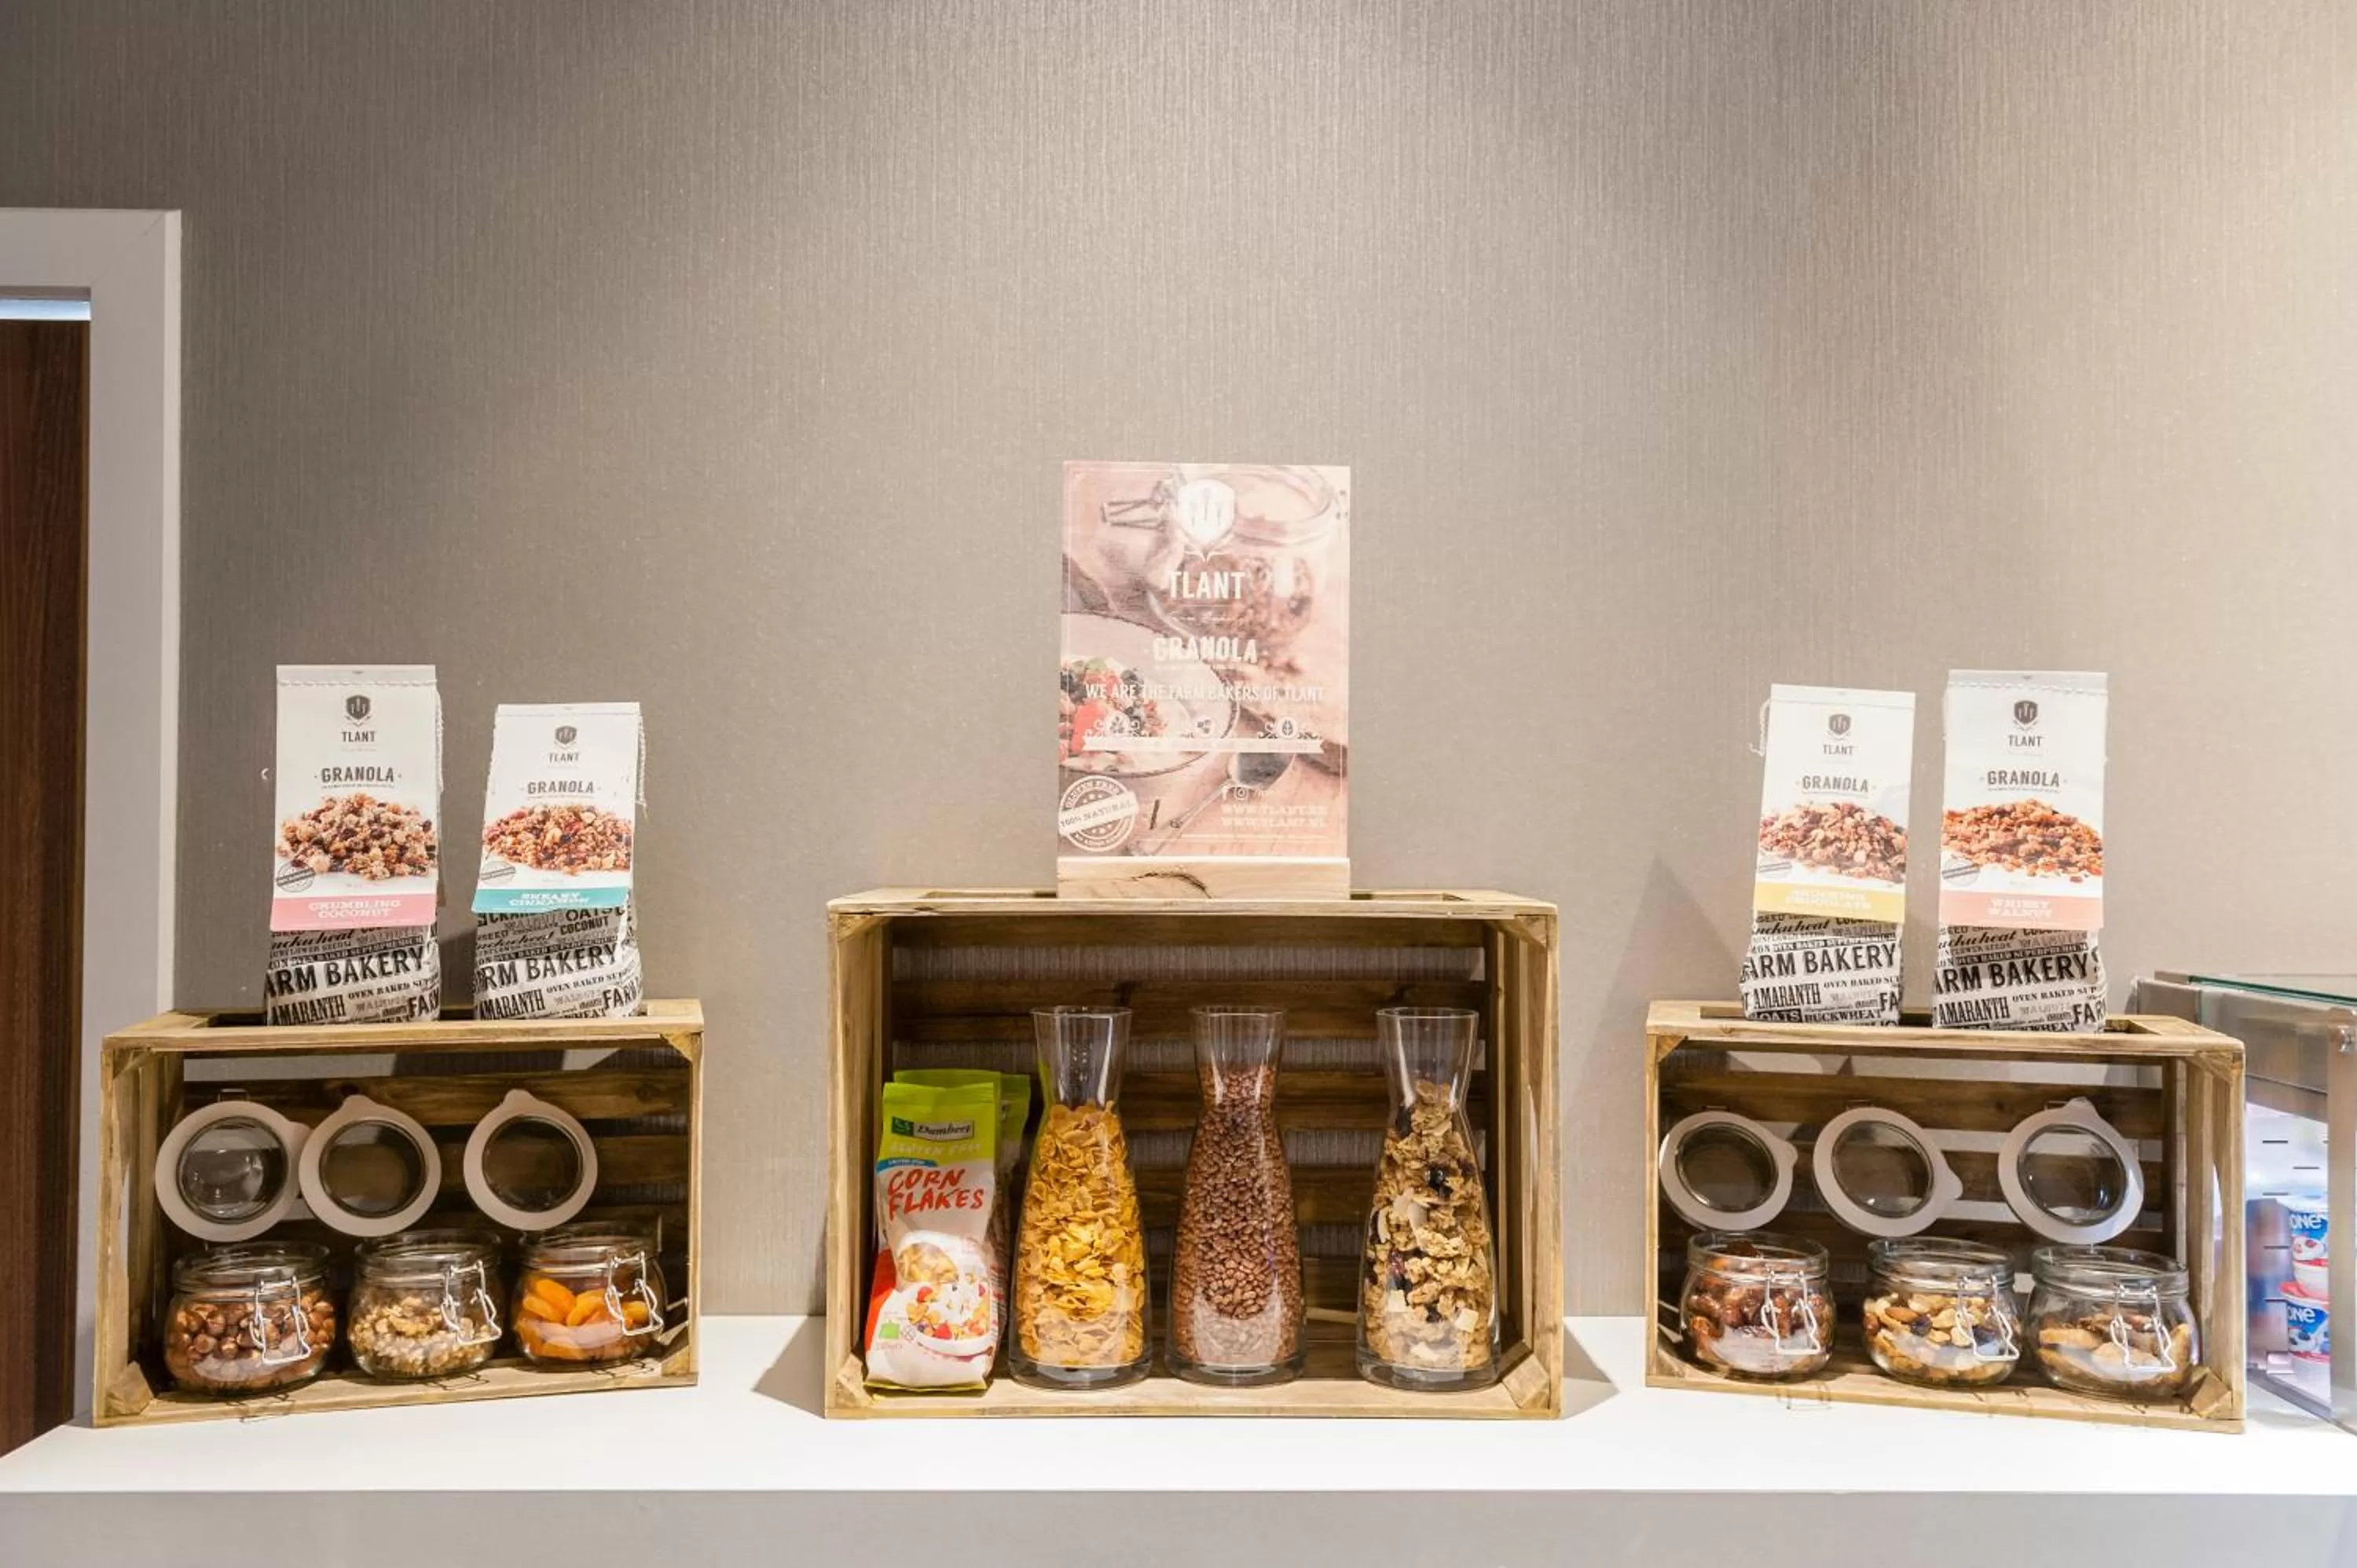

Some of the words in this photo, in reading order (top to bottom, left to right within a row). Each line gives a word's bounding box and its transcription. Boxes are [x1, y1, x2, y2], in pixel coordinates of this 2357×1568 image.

[1169, 571, 1245, 599] TLANT
[1153, 636, 1258, 664] GRANOLA
[1084, 683, 1106, 698] WE
[1112, 684, 1137, 699] ARE
[1142, 684, 1166, 699] THE
[1209, 685, 1259, 701] BAKERS
[1263, 686, 1279, 701] OF
[1285, 686, 1324, 702] TLANT
[342, 731, 376, 742] TLANT
[2008, 735, 2045, 747] TLANT
[547, 753, 580, 763] TLANT
[1822, 744, 1857, 755] TLANT
[321, 767, 394, 782] GRANOLA
[1802, 775, 1869, 793] GRANOLA
[1987, 770, 2060, 787] GRANOLA
[527, 780, 594, 794] GRANOLA
[317, 909, 391, 918] COCONUT
[560, 916, 610, 936] COCONUT
[525, 943, 617, 982] BAKERY
[1803, 943, 1897, 974] BAKERY
[264, 965, 317, 1000] ARM
[324, 946, 425, 989] BAKERY
[1934, 965, 1981, 995] ARM
[1988, 952, 2089, 988] BAKERY
[348, 989, 374, 1000] OVEN
[1753, 982, 1822, 1009] AMARANTH
[2012, 992, 2037, 1002] OVEN
[269, 994, 346, 1026] AMARANTH
[1804, 1009, 1882, 1023] BUCKWHEAT
[1938, 995, 2011, 1024] AMARANTH
[887, 1169, 966, 1196] CORN
[888, 1187, 985, 1222] FLAKES
